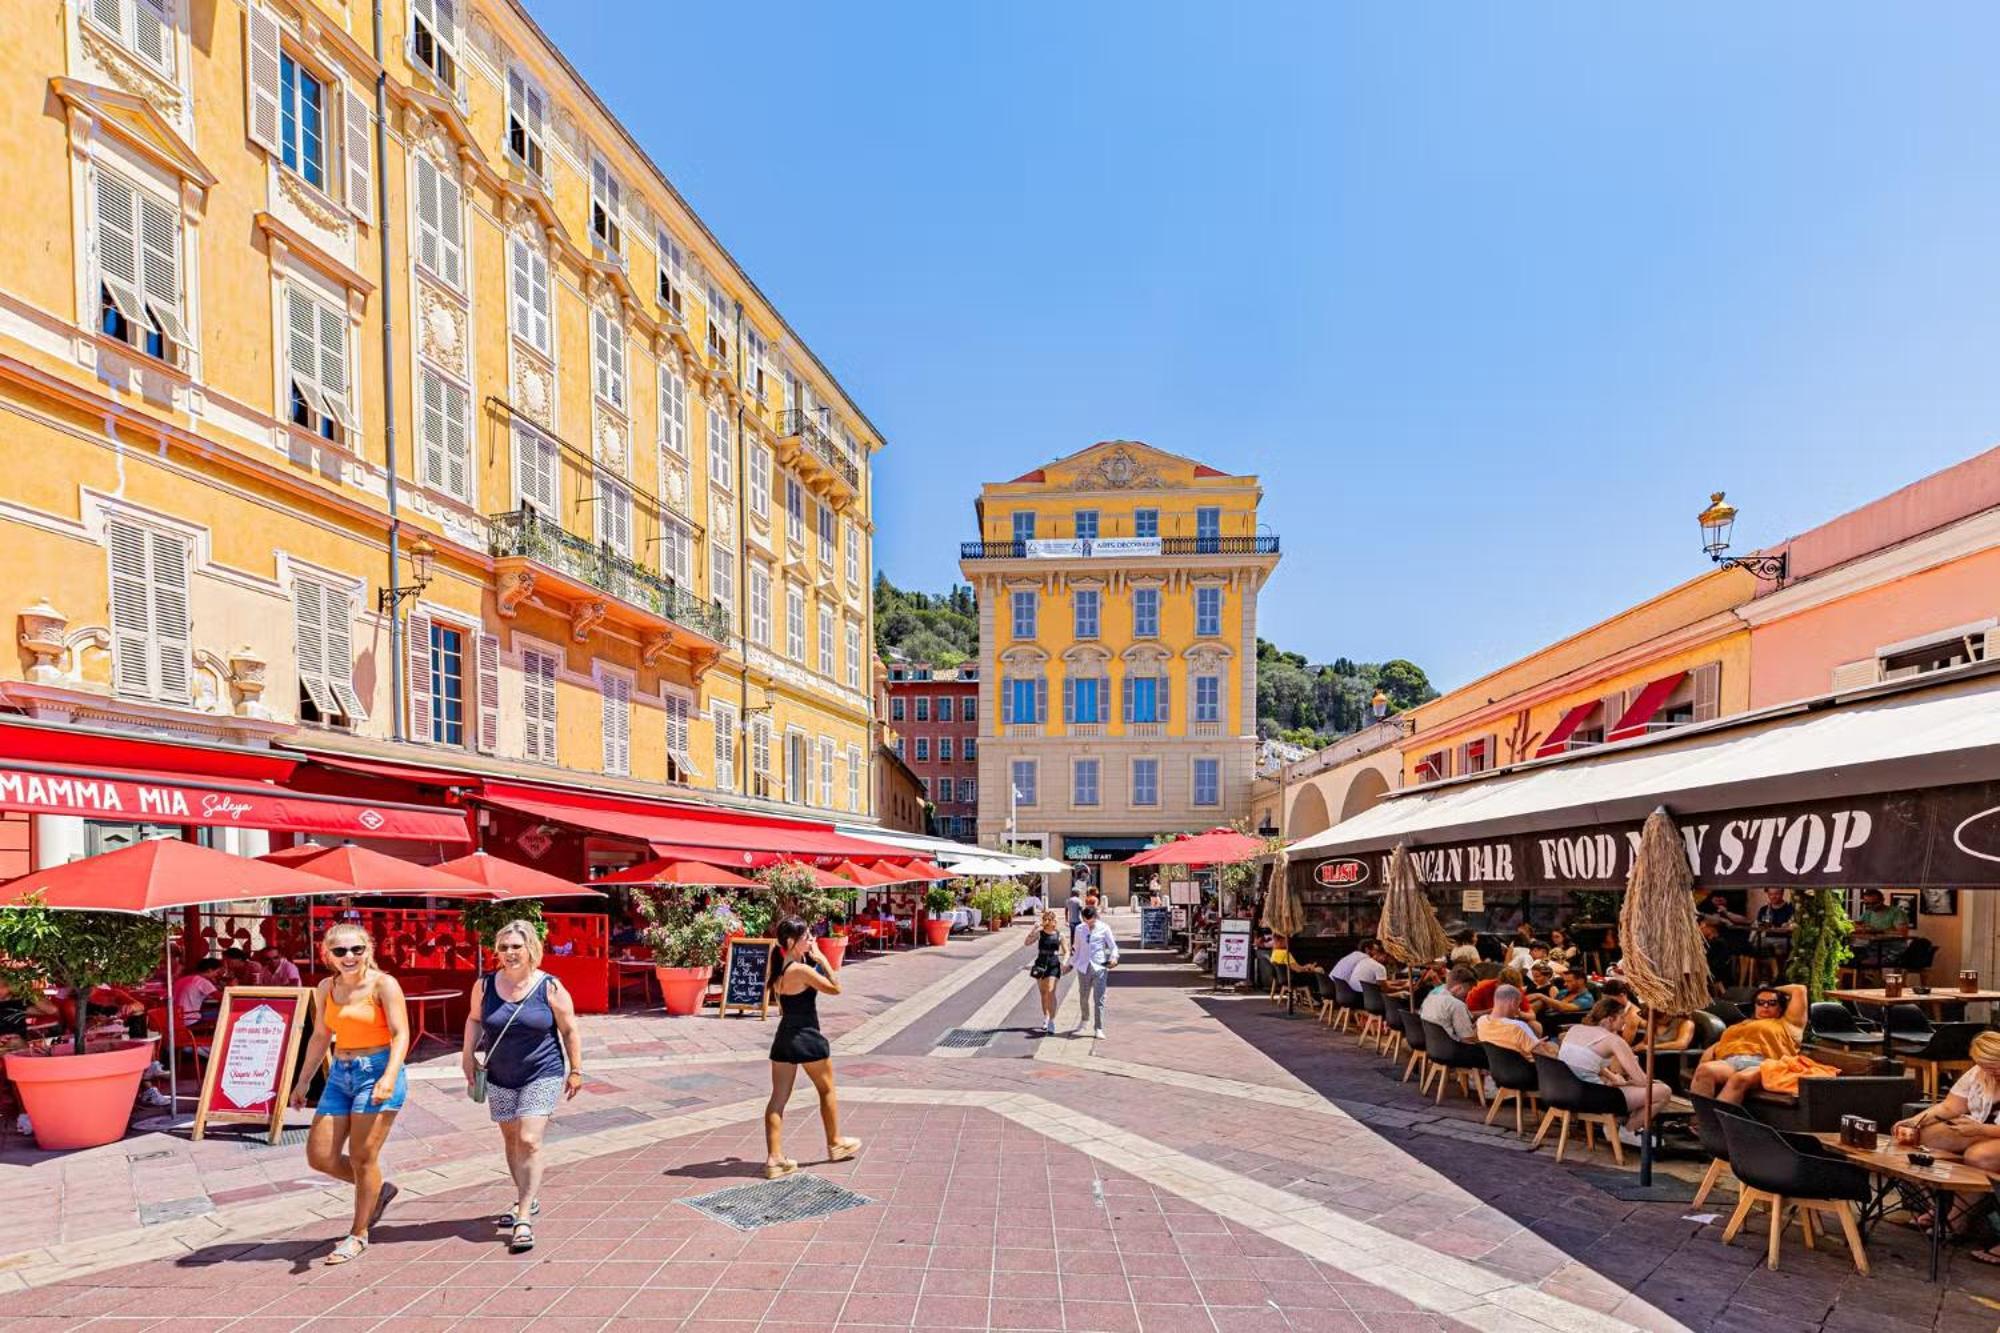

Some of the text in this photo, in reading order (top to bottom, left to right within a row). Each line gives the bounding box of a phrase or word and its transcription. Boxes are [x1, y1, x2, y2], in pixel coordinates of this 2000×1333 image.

[0, 773, 253, 819] MAMMA MIA Saleya
[1468, 843, 1515, 882] BAR
[1539, 833, 1617, 880] FOOD
[1714, 810, 1873, 876] STOP
